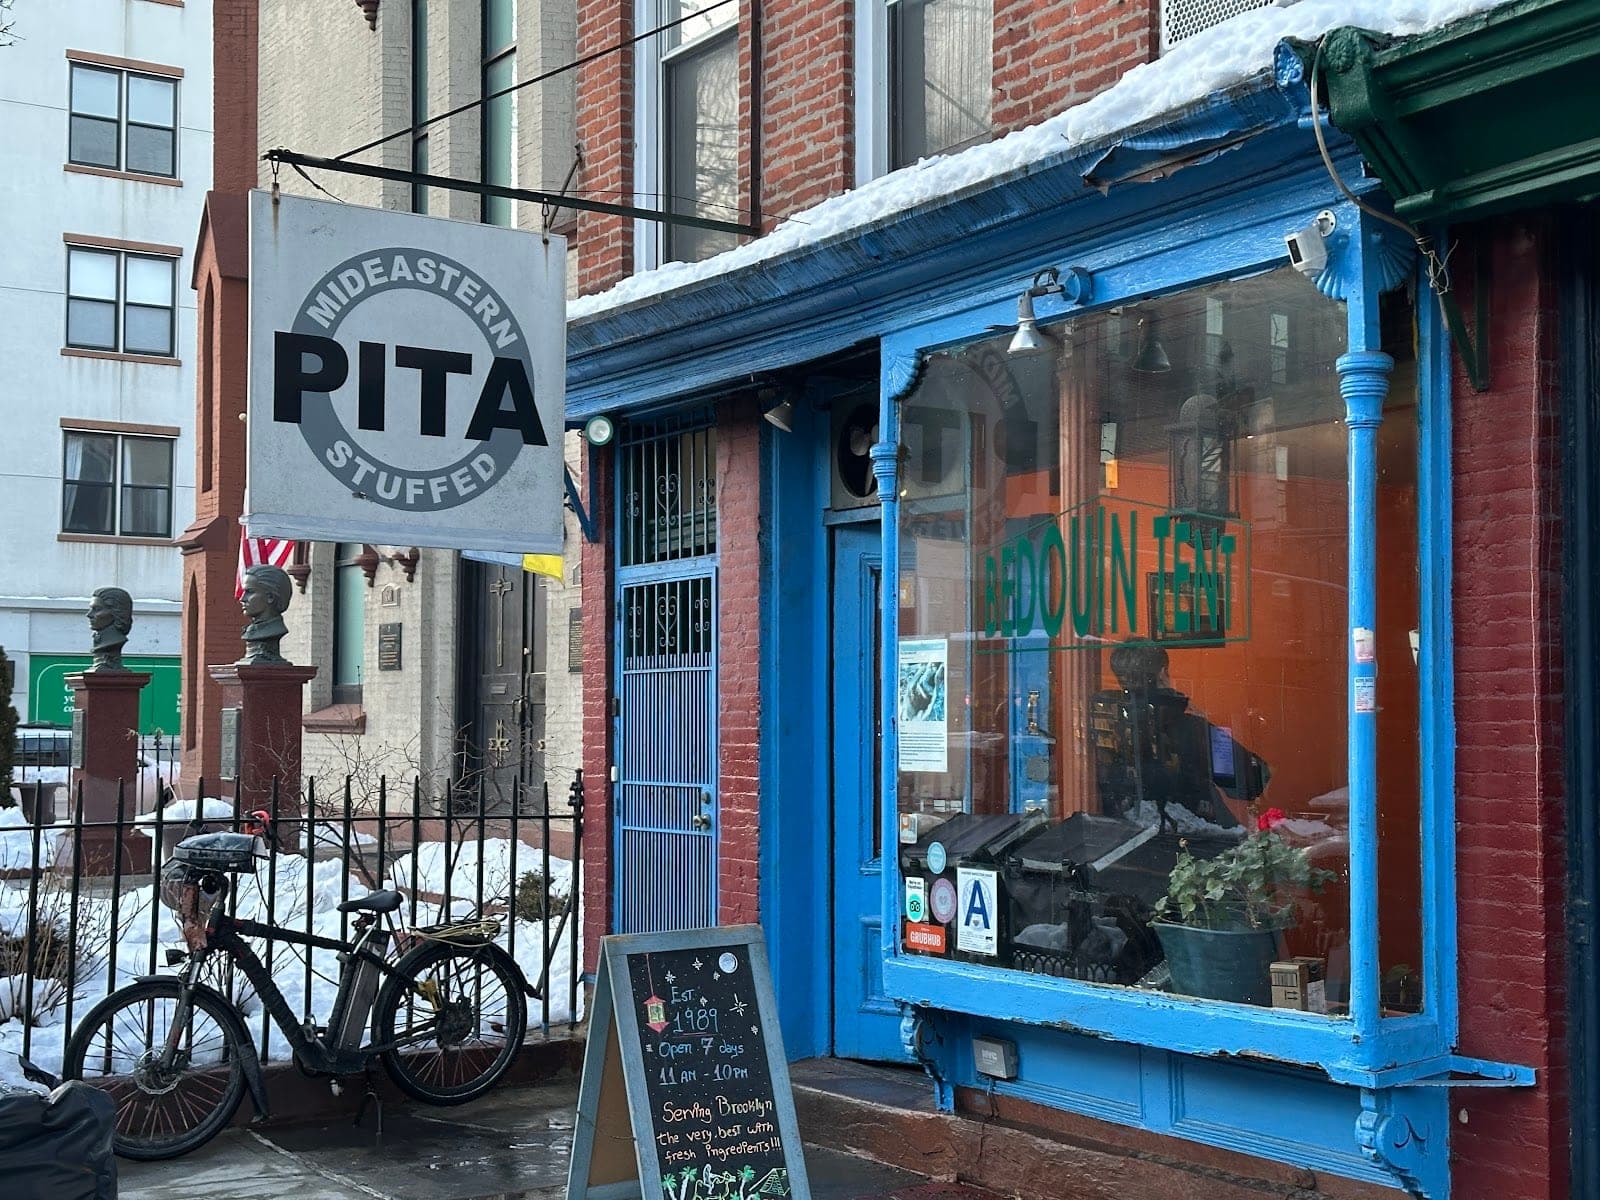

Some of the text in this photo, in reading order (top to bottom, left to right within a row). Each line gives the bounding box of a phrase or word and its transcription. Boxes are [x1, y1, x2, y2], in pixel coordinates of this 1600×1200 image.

[306, 255, 518, 349] MIDEASTERN
[274, 331, 549, 447] PITA
[326, 440, 496, 504] STUFFED
[984, 506, 1236, 639] BEDOUIN TENT
[964, 880, 990, 929] A
[910, 931, 941, 946] GRUBHUB
[673, 1008, 718, 1033] 1989
[659, 1037, 744, 1059] Open 7 days
[663, 1095, 773, 1123] Serving Brooklyn
[656, 1131, 680, 1145] the
[686, 1129, 712, 1145] very
[665, 1149, 696, 1165] fresh
